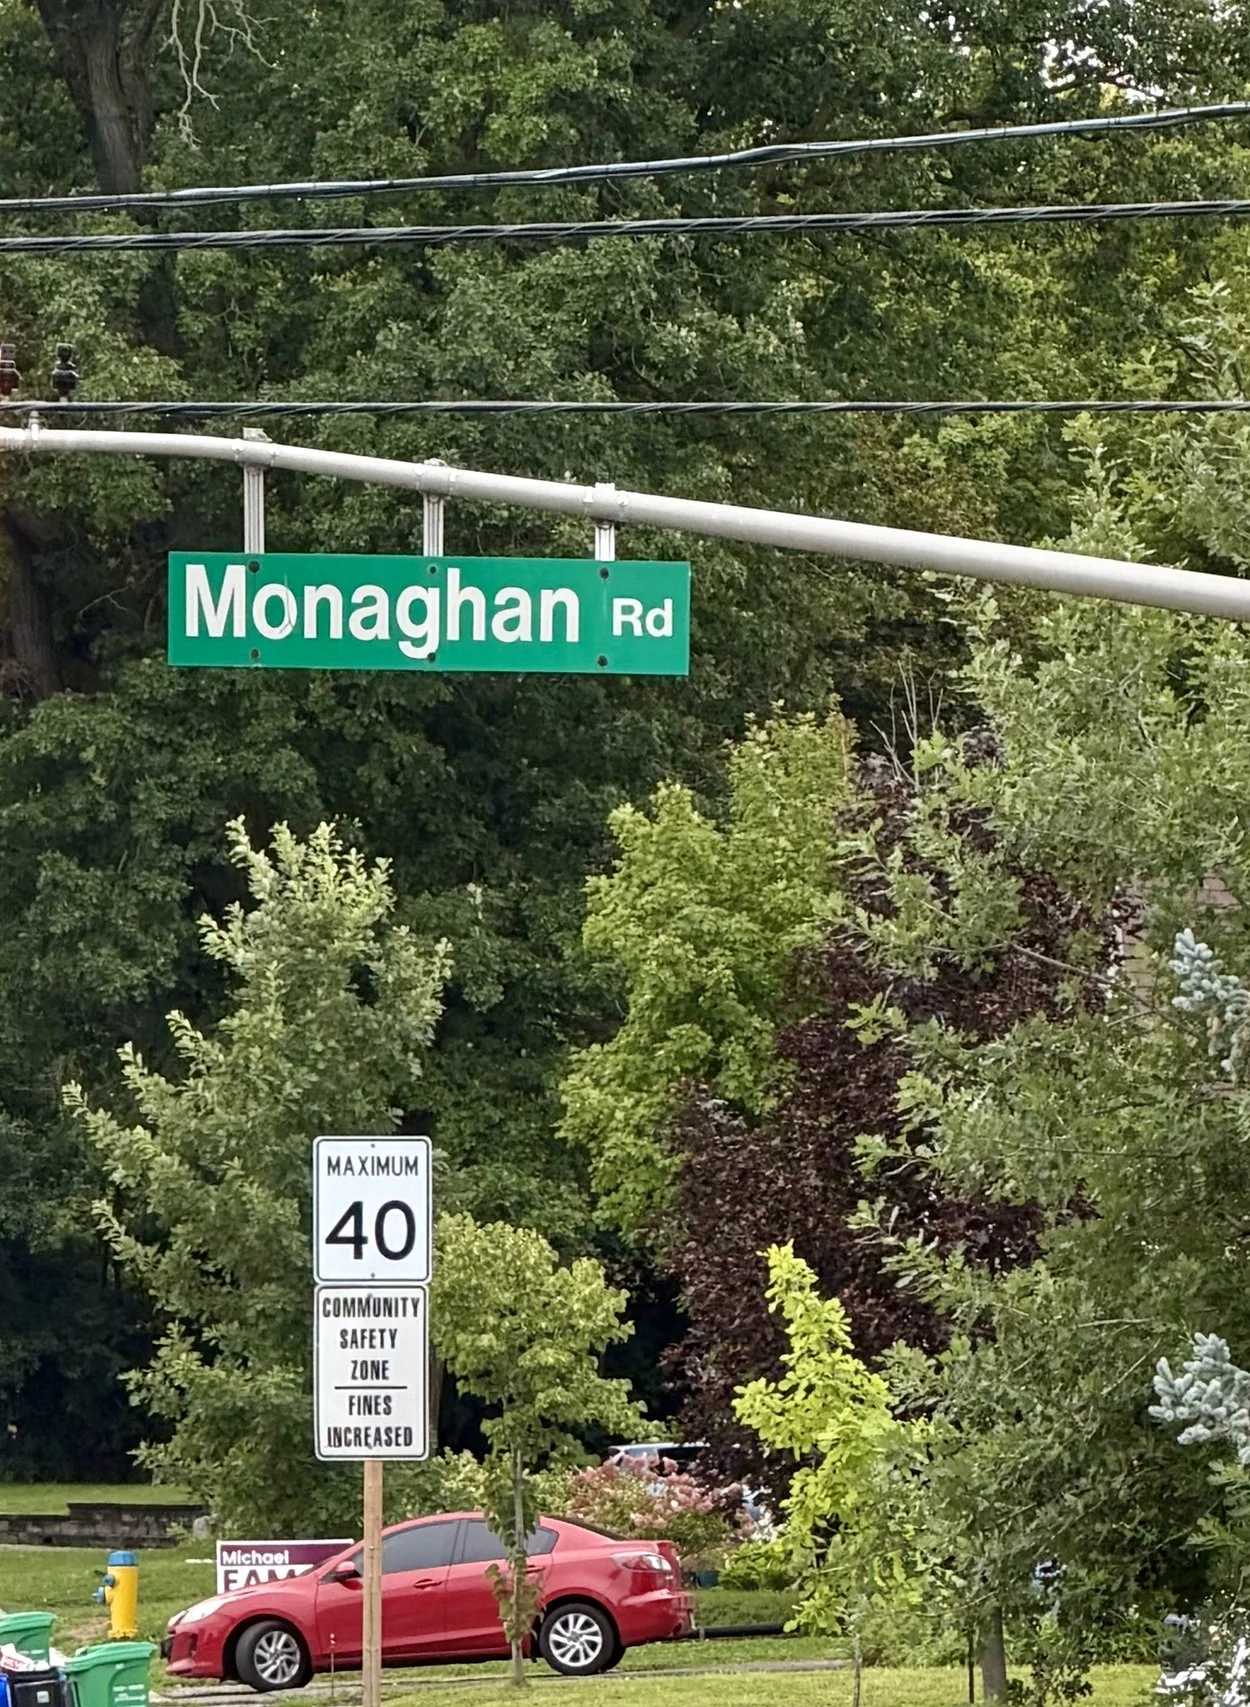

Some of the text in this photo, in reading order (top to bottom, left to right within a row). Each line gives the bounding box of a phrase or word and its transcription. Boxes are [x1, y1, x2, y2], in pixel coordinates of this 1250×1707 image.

[185, 564, 674, 660] Monaghan Rd
[327, 1156, 419, 1177] MAXIMUM
[325, 1200, 417, 1261] 40
[322, 1297, 420, 1319] COMMUNITY
[339, 1328, 398, 1350] SAFETY
[351, 1360, 390, 1381] ZONE
[348, 1395, 392, 1416] FINES
[327, 1426, 413, 1447] INCREASED
[222, 1549, 290, 1565] Michael
